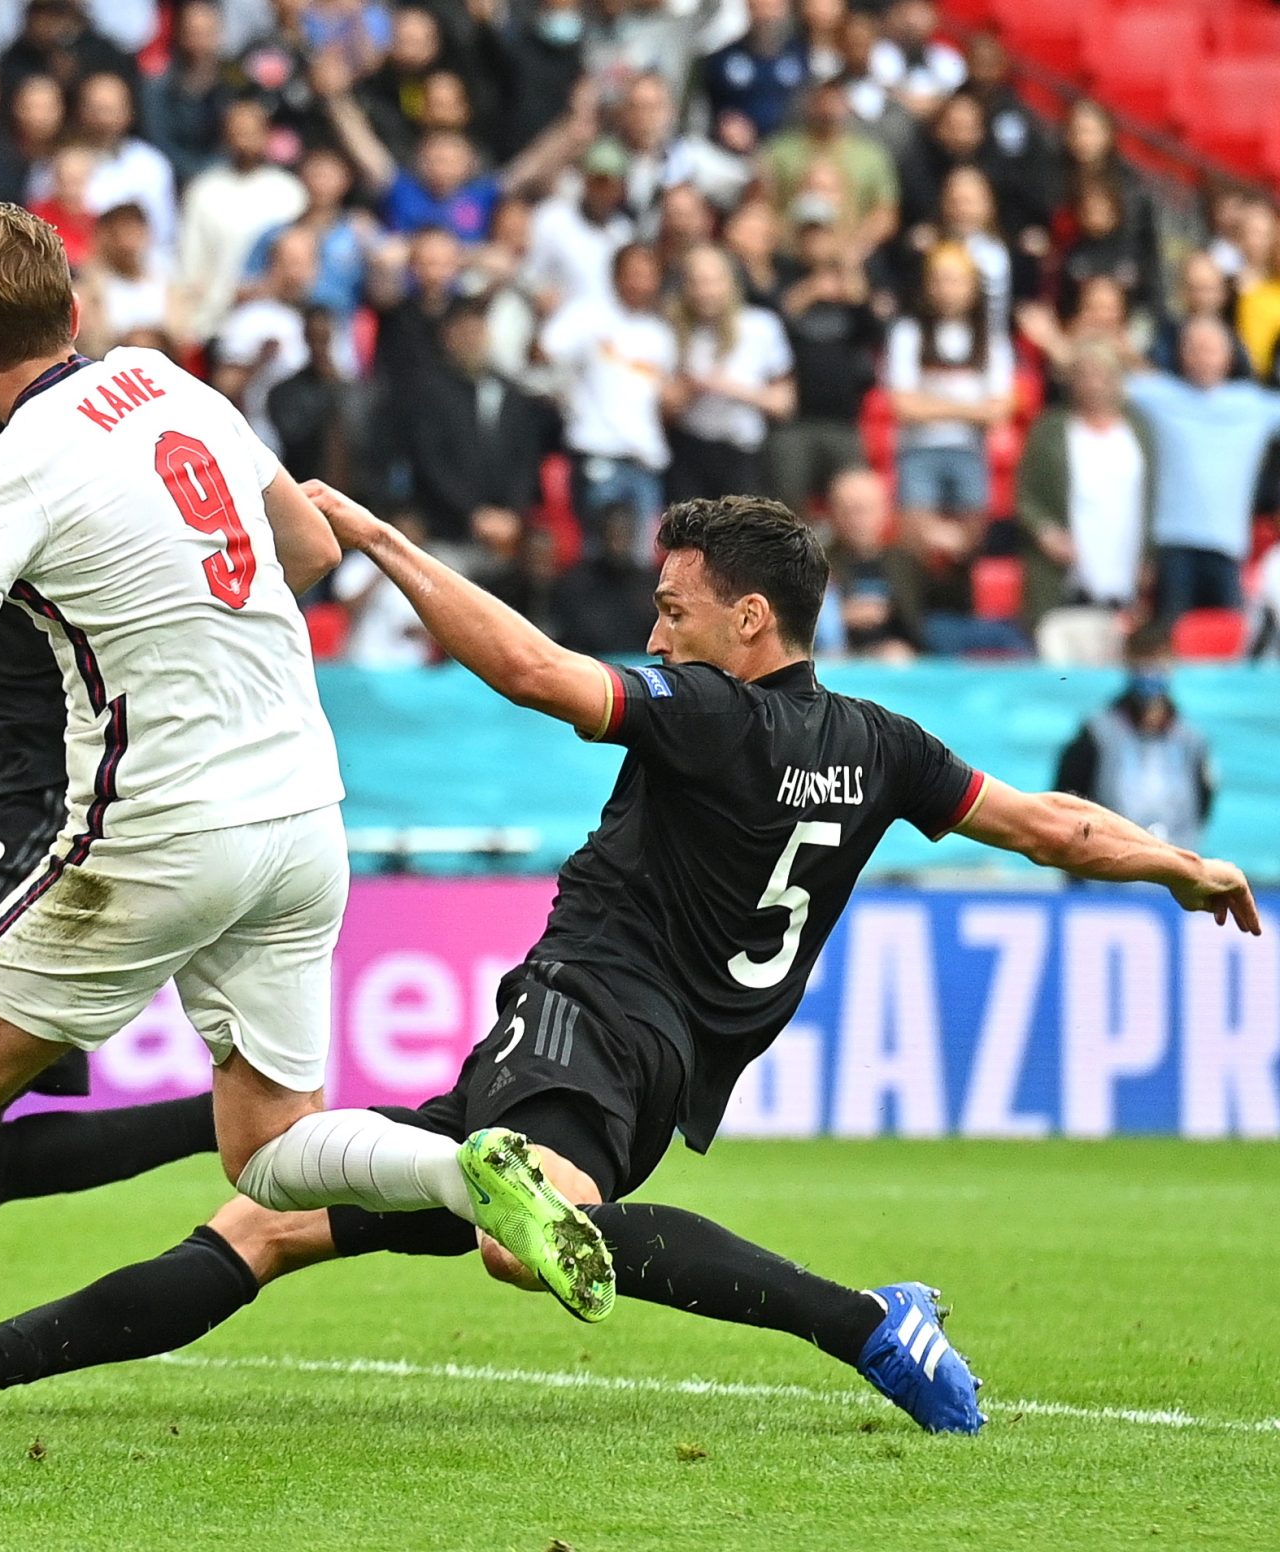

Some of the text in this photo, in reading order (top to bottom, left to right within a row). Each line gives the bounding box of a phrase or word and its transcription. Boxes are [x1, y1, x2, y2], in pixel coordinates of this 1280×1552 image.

[76, 367, 166, 433] KANE
[154, 430, 257, 610] 9
[727, 820, 842, 989] 5
